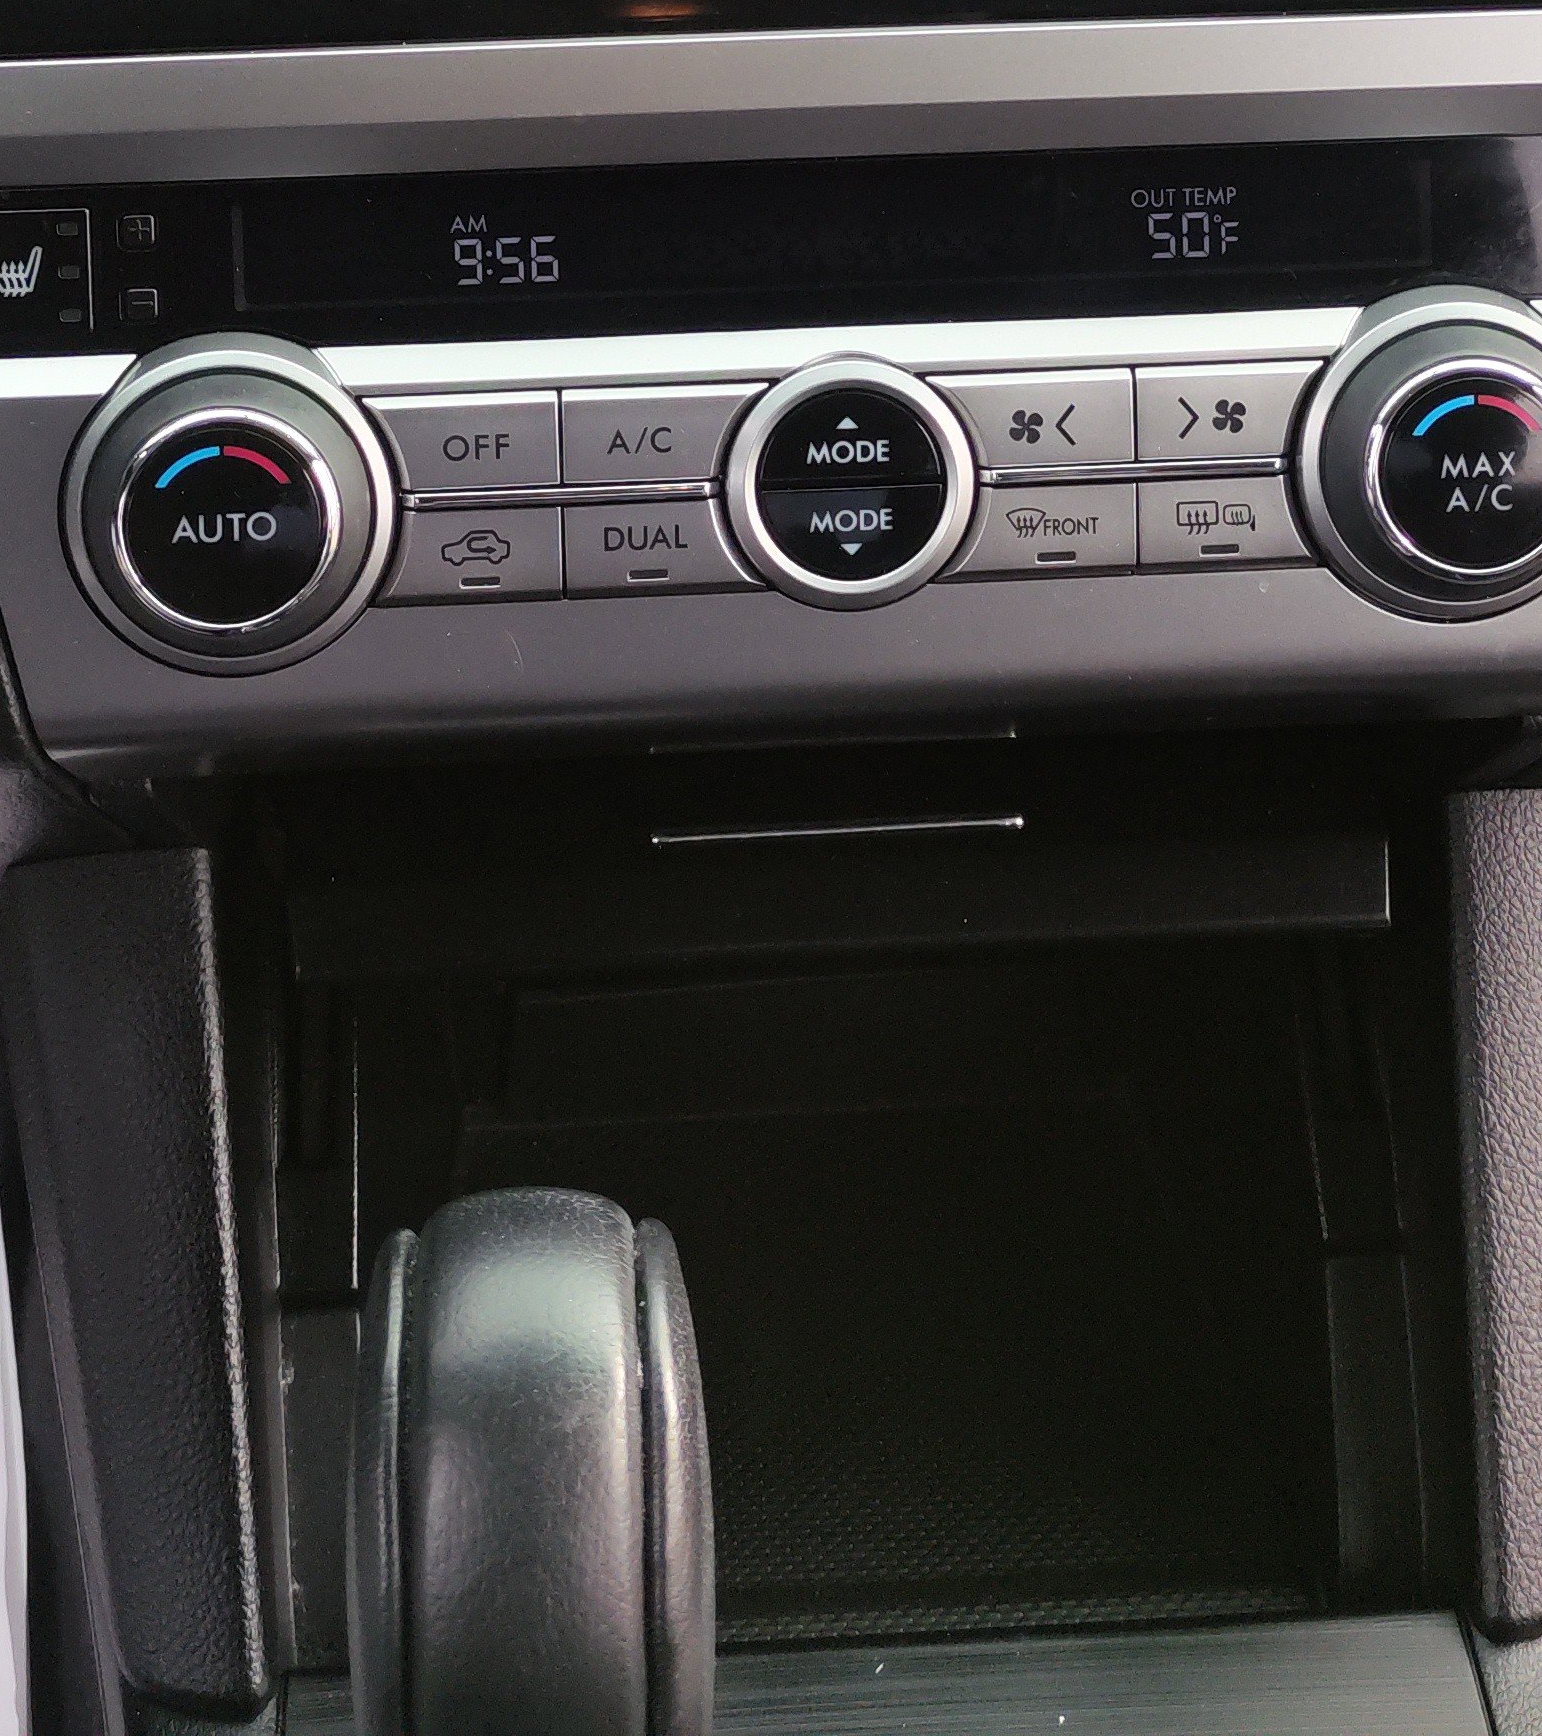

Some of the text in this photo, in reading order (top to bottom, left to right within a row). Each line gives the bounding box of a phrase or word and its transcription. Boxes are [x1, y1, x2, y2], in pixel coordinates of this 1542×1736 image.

[1130, 186, 1237, 208] OUT TEMP
[450, 215, 487, 233] AM
[454, 235, 559, 286] 9:56
[442, 433, 510, 462] OFF
[606, 426, 672, 455] A/C
[806, 439, 890, 464] MODE
[1441, 451, 1516, 481] MAX
[1446, 482, 1514, 513] A/C
[172, 511, 278, 544] AUTO
[810, 508, 892, 532] MODE
[1042, 514, 1100, 538] FRONT
[603, 524, 689, 552] DUAL
